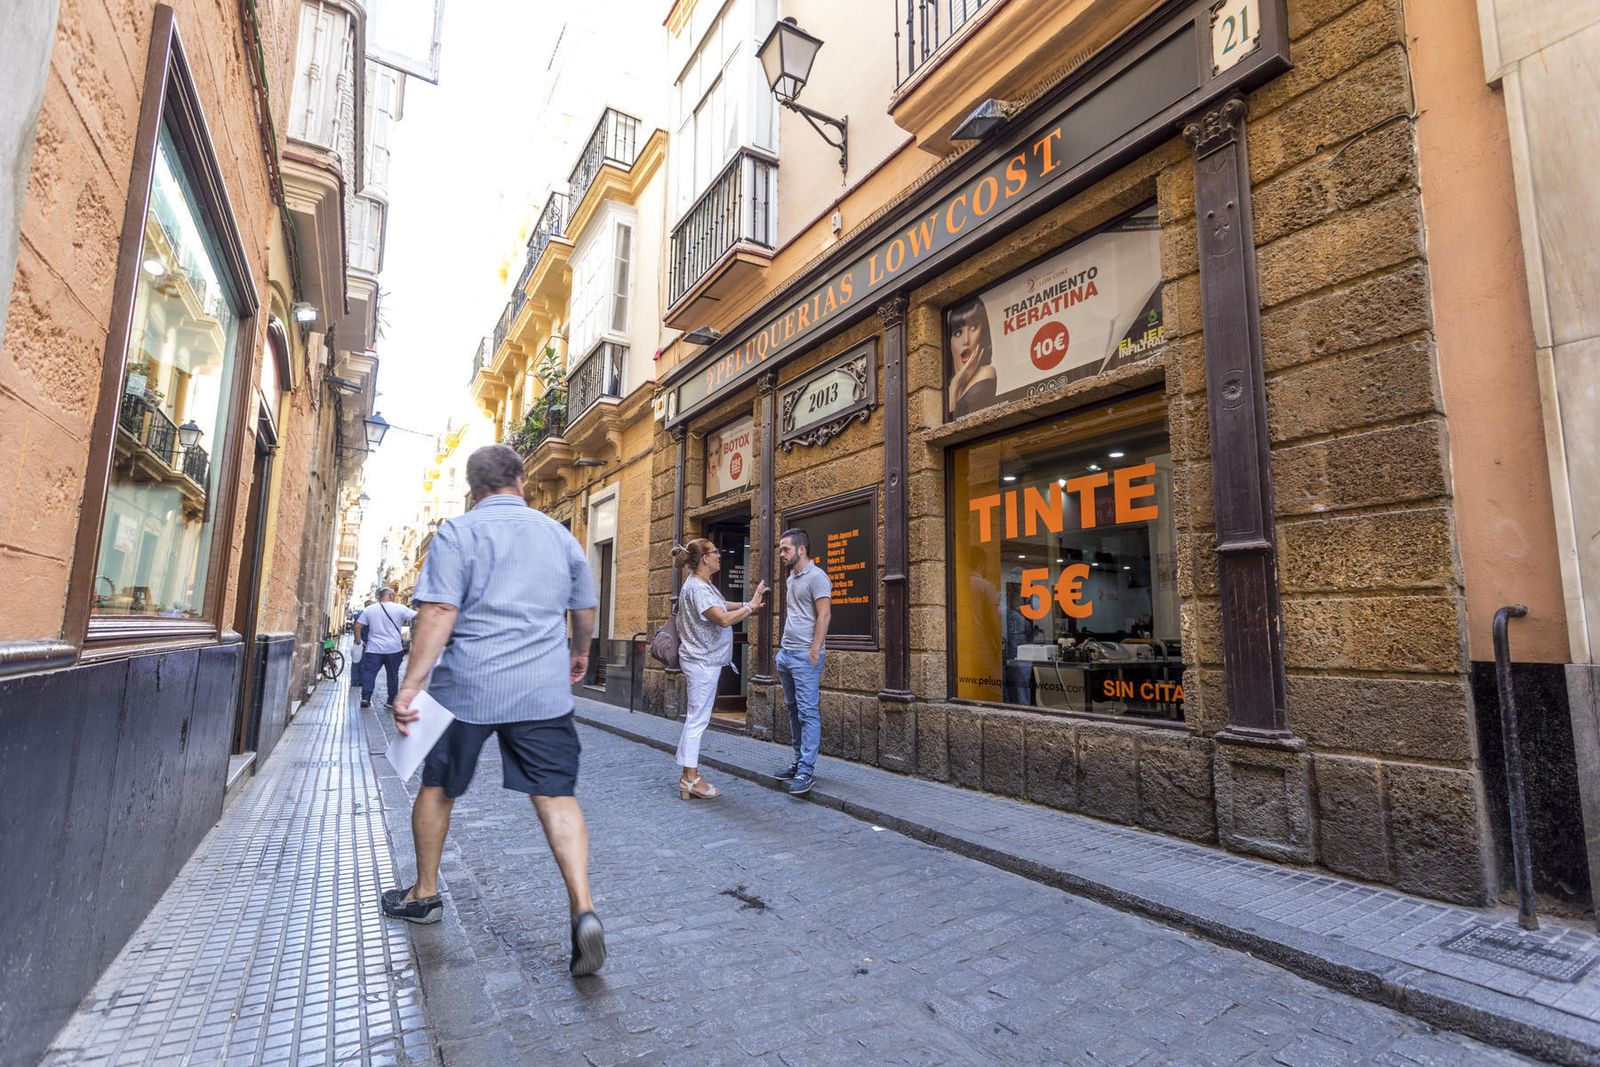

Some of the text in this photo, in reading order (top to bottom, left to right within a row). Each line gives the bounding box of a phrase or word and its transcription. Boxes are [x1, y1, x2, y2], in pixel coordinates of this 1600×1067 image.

[1221, 5, 1250, 55] 21
[1003, 266, 1098, 319] TRATAMIENTO
[1003, 281, 1099, 337] KERATINA
[716, 272, 853, 384] PELUQUERIAS
[1033, 331, 1065, 360] 10€
[808, 382, 839, 413] 2013
[723, 432, 750, 455] BOTOX
[969, 462, 1159, 543] TINTE
[1019, 563, 1094, 620] 5€
[1103, 679, 1185, 702] SIN CITA
